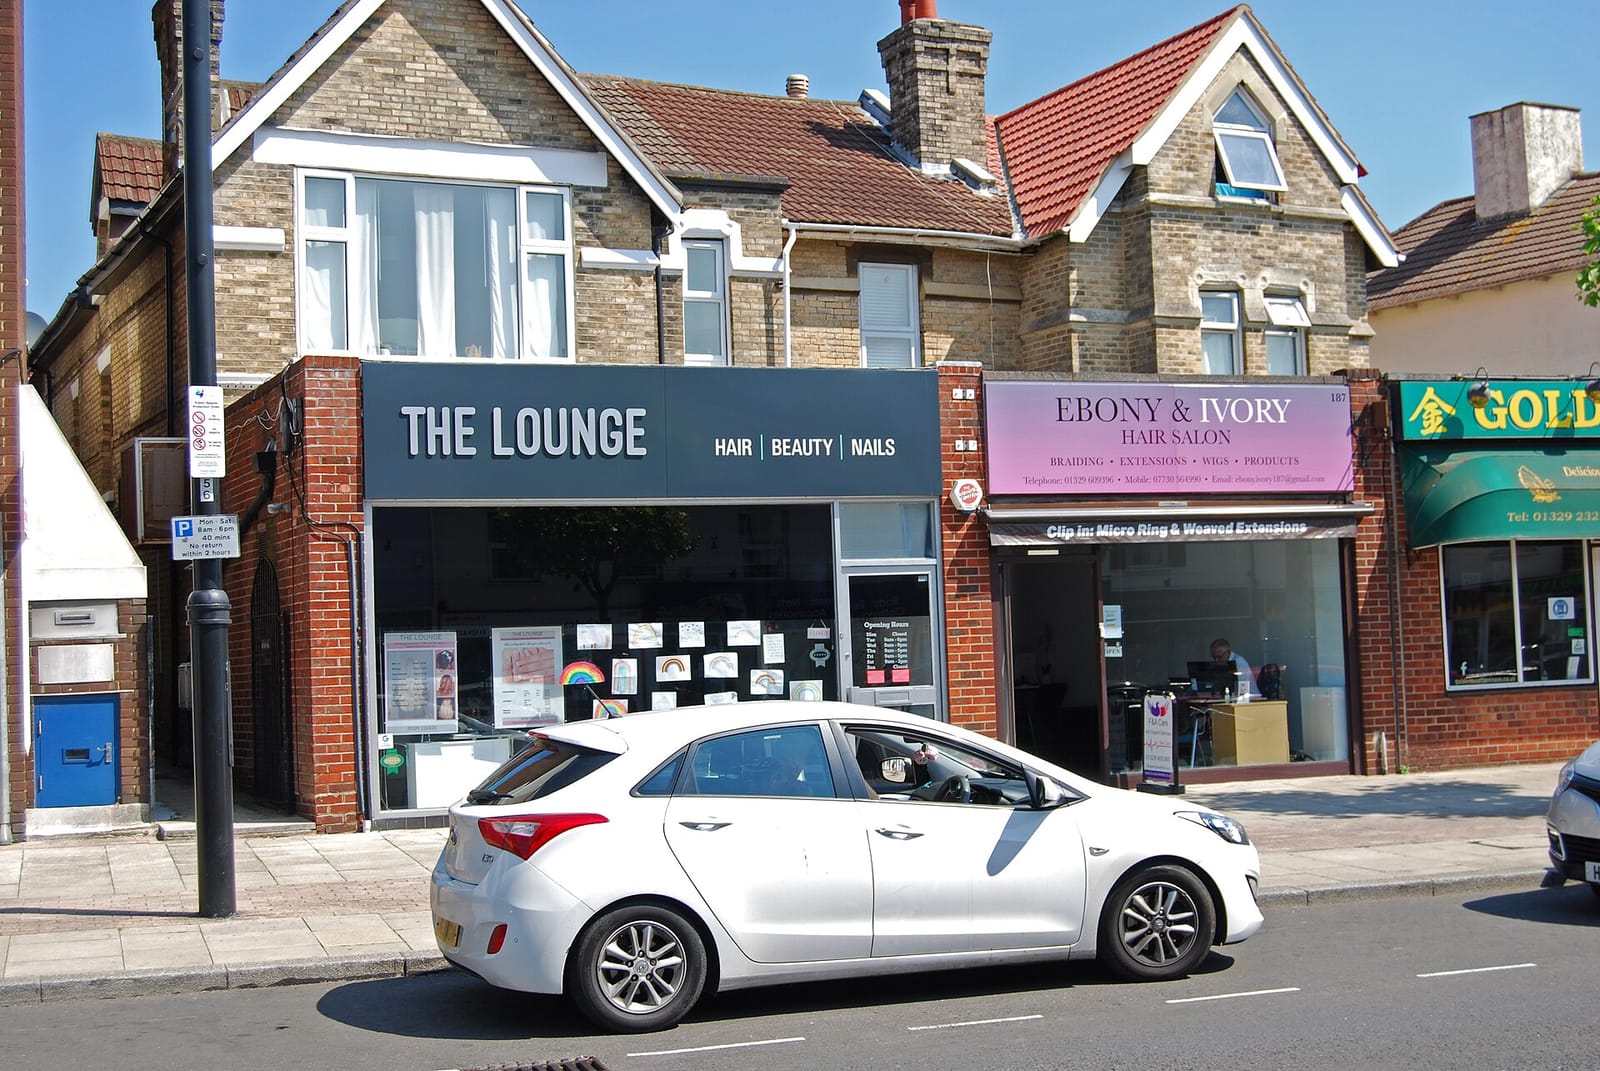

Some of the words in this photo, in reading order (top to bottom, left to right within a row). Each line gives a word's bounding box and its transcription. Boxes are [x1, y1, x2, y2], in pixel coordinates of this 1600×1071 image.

[1330, 392, 1347, 403] 187
[1055, 396, 1163, 423] EBONY
[1172, 398, 1193, 423] &
[1199, 397, 1292, 424] IVORY
[1408, 386, 1456, 436] 金
[400, 405, 478, 457] THE
[492, 405, 648, 457] LOUNGE
[1121, 429, 1168, 445] HAIR
[1172, 429, 1232, 445] SALON
[715, 438, 753, 457] HAIR
[771, 438, 834, 457] BEAUTY
[851, 438, 896, 457] NAILS
[1049, 456, 1104, 467] BRAIDING
[1119, 456, 1187, 467] EXTENSIONS
[1202, 456, 1229, 467] WIGS
[1244, 456, 1300, 467] PRODUCTS
[203, 478, 211, 488] 5
[1022, 475, 1063, 487] Telephone:
[1124, 475, 1152, 484] Mobile:
[1212, 474, 1234, 484] Email:
[203, 490, 211, 500] 6
[1507, 511, 1530, 523] Tel:
[1532, 511, 1573, 522] 01329
[1575, 511, 1600, 522] 232
[178, 521, 190, 536] P
[218, 525, 235, 533] 6pm
[1046, 525, 1075, 540] Clip
[1076, 525, 1095, 538] in:
[1096, 524, 1136, 537] Micro
[1137, 523, 1169, 538] Ring
[1170, 522, 1181, 536] &
[1182, 521, 1235, 536] Weaved
[1236, 520, 1308, 535] Extensions
[201, 541, 223, 549] return
[182, 550, 203, 558] within
[863, 620, 891, 630] Opening
[1592, 863, 1600, 881] H
